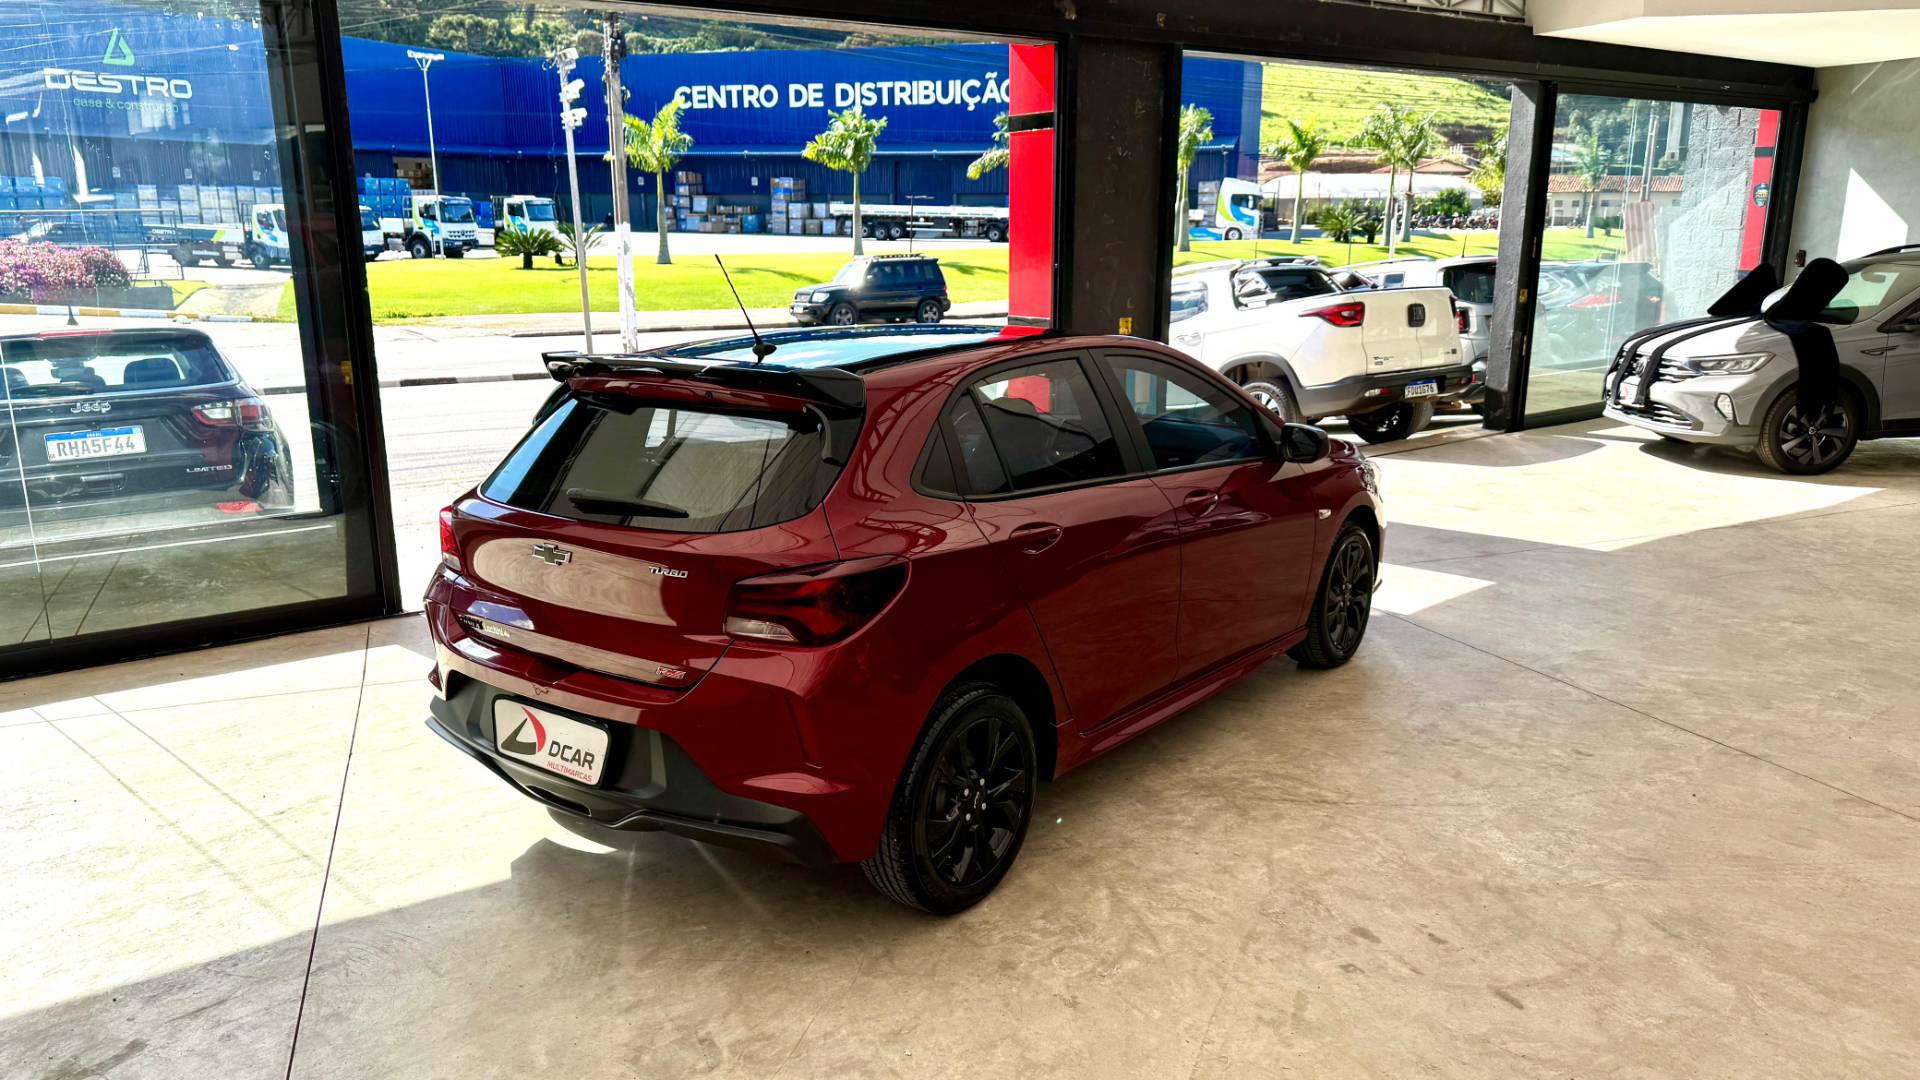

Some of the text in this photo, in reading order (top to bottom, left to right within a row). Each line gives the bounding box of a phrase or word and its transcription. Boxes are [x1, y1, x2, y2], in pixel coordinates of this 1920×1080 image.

[43, 67, 193, 99] DESTRO
[674, 84, 779, 109] CENTRO
[788, 83, 824, 108] DE
[70, 401, 112, 414] Jeep
[56, 436, 136, 458] RHA5F44
[186, 464, 233, 473] LIMITED
[648, 566, 689, 579] TURBO
[548, 740, 595, 771] DCAR
[546, 760, 593, 783] MULTIMARCAS
